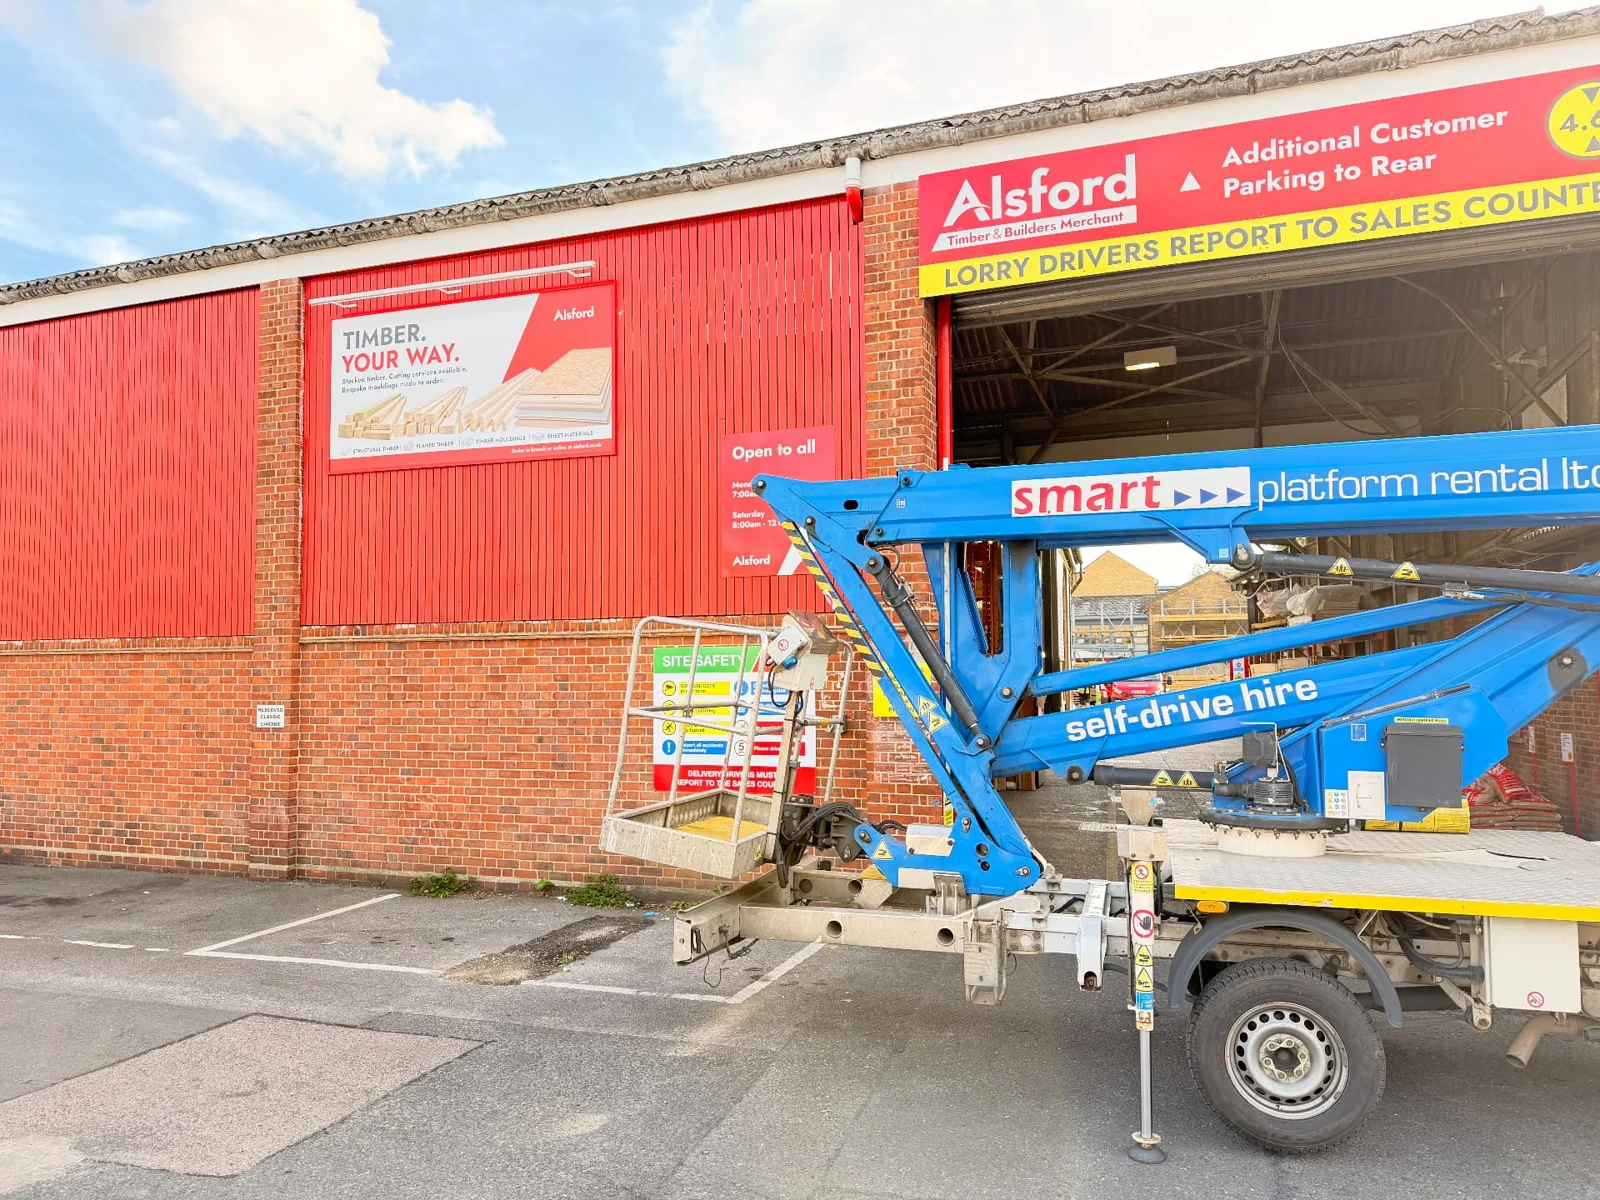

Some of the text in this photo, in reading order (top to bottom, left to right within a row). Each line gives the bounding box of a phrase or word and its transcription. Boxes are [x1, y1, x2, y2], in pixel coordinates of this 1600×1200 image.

[1222, 110, 1508, 168] Additional Customer
[1224, 153, 1437, 198] Parking to Rear
[943, 153, 1137, 227] Alsford
[947, 211, 1124, 246] Timber & Builders Merchant
[945, 257, 1030, 288] LORRY
[1039, 239, 1159, 275] DRIVERS
[1171, 222, 1287, 257] REPORT
[1296, 216, 1338, 241] TO
[1350, 200, 1452, 234] SALES
[553, 305, 594, 322] Alsford
[342, 323, 426, 349] TIMBER.
[341, 343, 459, 373] YOUR WAY.
[412, 370, 437, 378] services
[732, 439, 816, 462] Open to all
[1013, 475, 1161, 515] smart
[1258, 468, 1419, 511] platform
[1431, 458, 1549, 495] rental
[732, 510, 765, 519] Saturday
[732, 521, 761, 529] 8:00am
[767, 519, 777, 527] 12
[732, 554, 770, 566] Alsford
[662, 655, 691, 667] SITE
[1066, 678, 1318, 742] self-drive hire
[738, 742, 745, 751] 5
[687, 769, 722, 777] DELIVERY
[705, 779, 715, 787] TO
[716, 779, 731, 787] TE
[732, 780, 755, 788] SAES
